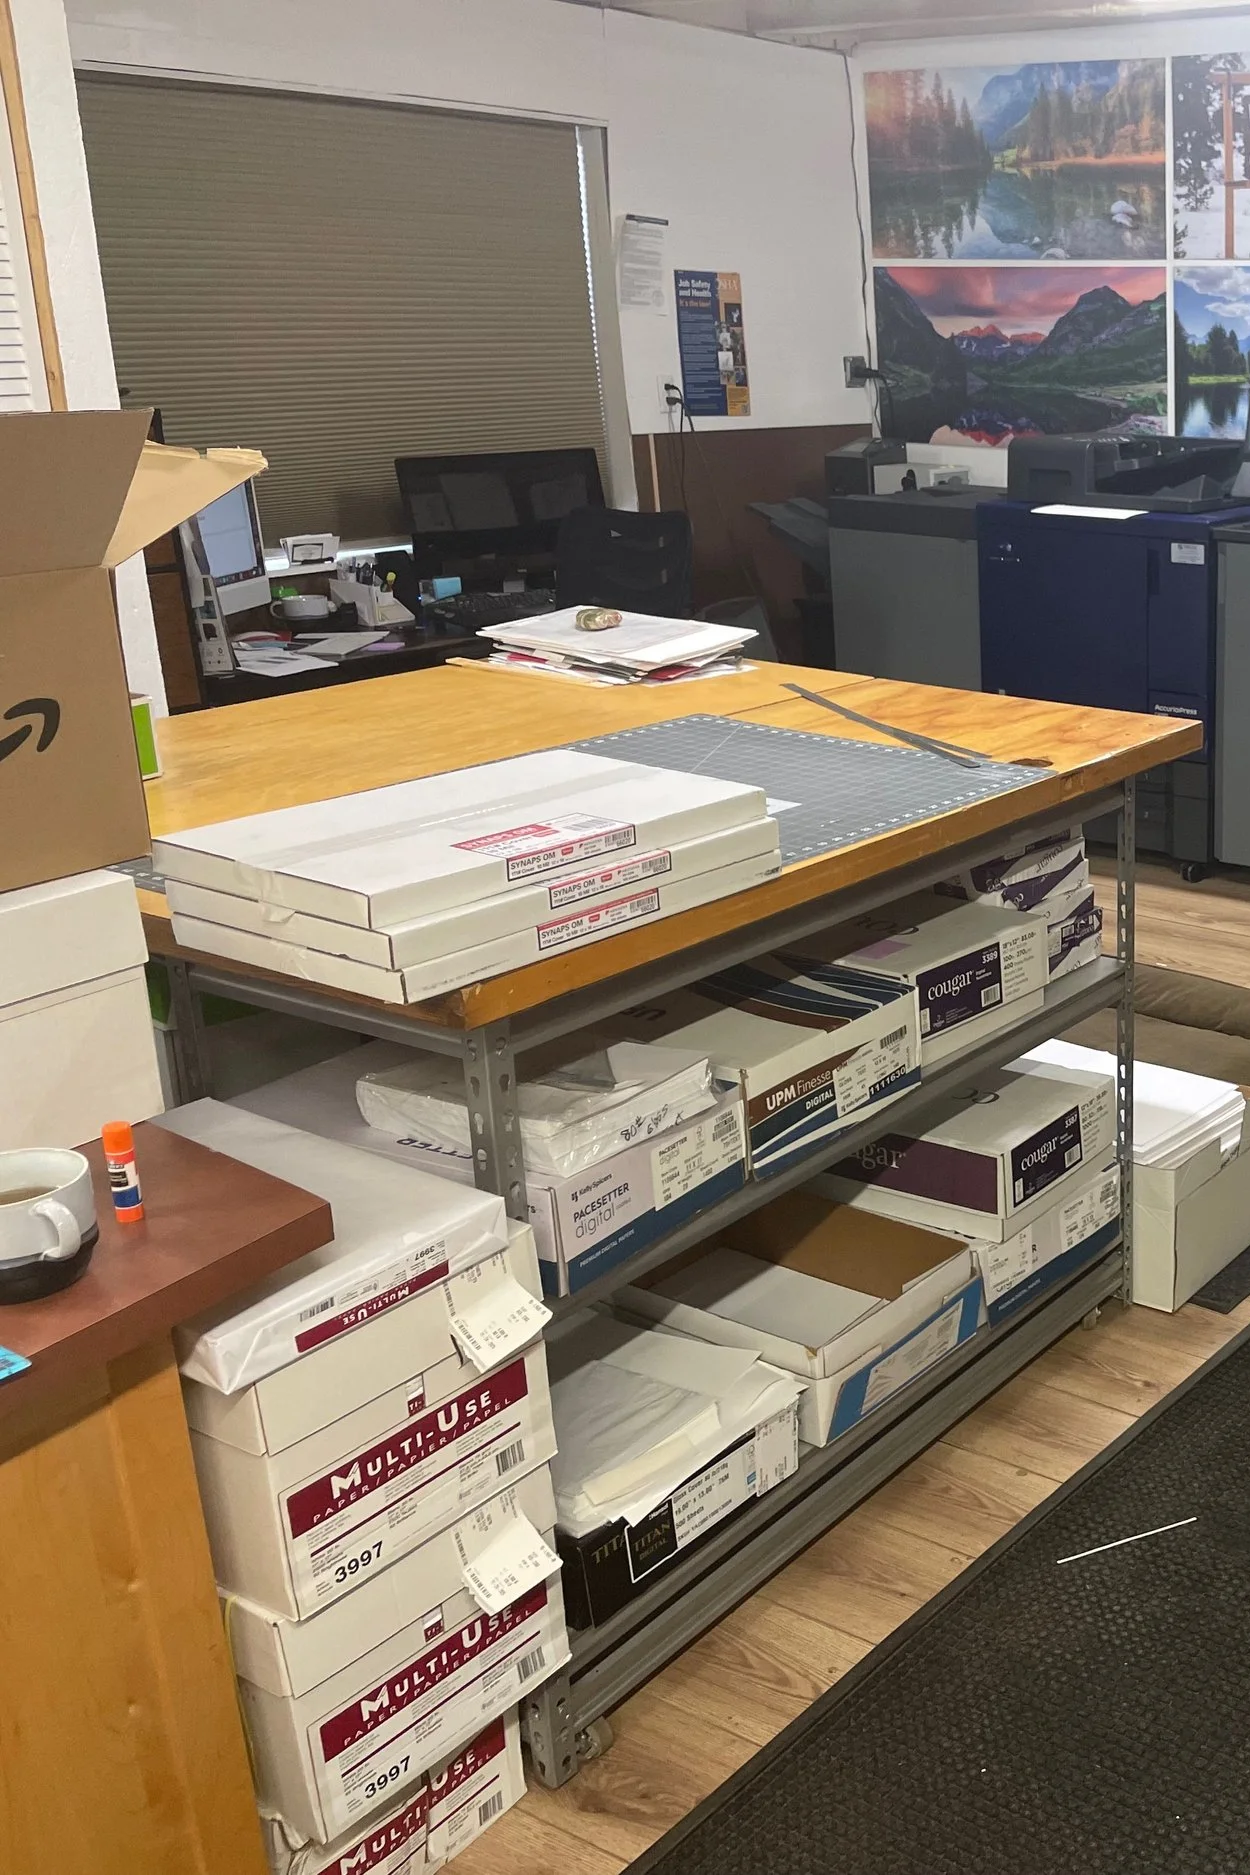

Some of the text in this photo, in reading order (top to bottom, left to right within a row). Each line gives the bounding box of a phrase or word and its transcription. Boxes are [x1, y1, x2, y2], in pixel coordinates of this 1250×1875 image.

[691, 279, 711, 290] Safety
[1154, 703, 1198, 716] AccurioPress
[510, 851, 556, 870] SYNAPS OM
[553, 878, 596, 898] SYNAPS OM
[541, 918, 583, 939] SYNAPS OM
[981, 950, 998, 964] 3389
[928, 969, 974, 1001] cougar
[765, 1070, 832, 1111] UPM Finesse
[869, 1065, 906, 1095] 1111630
[805, 1088, 834, 1111] DIGITAL
[658, 1136, 688, 1157] PACESETTER
[1020, 1135, 1060, 1172] cougar
[573, 1182, 630, 1223] PACESETTER
[575, 1203, 616, 1239] digital
[414, 1244, 436, 1261] 3997
[343, 1285, 410, 1326] MULTI-USE
[329, 1390, 491, 1500] MULTI-USE
[687, 1479, 703, 1493] Cover
[686, 1505, 705, 1521] Sheets
[632, 1520, 672, 1552] TITAN
[334, 1540, 383, 1584] 3997
[359, 1605, 513, 1723] MULTI-USE
[364, 1754, 411, 1800] 3997
